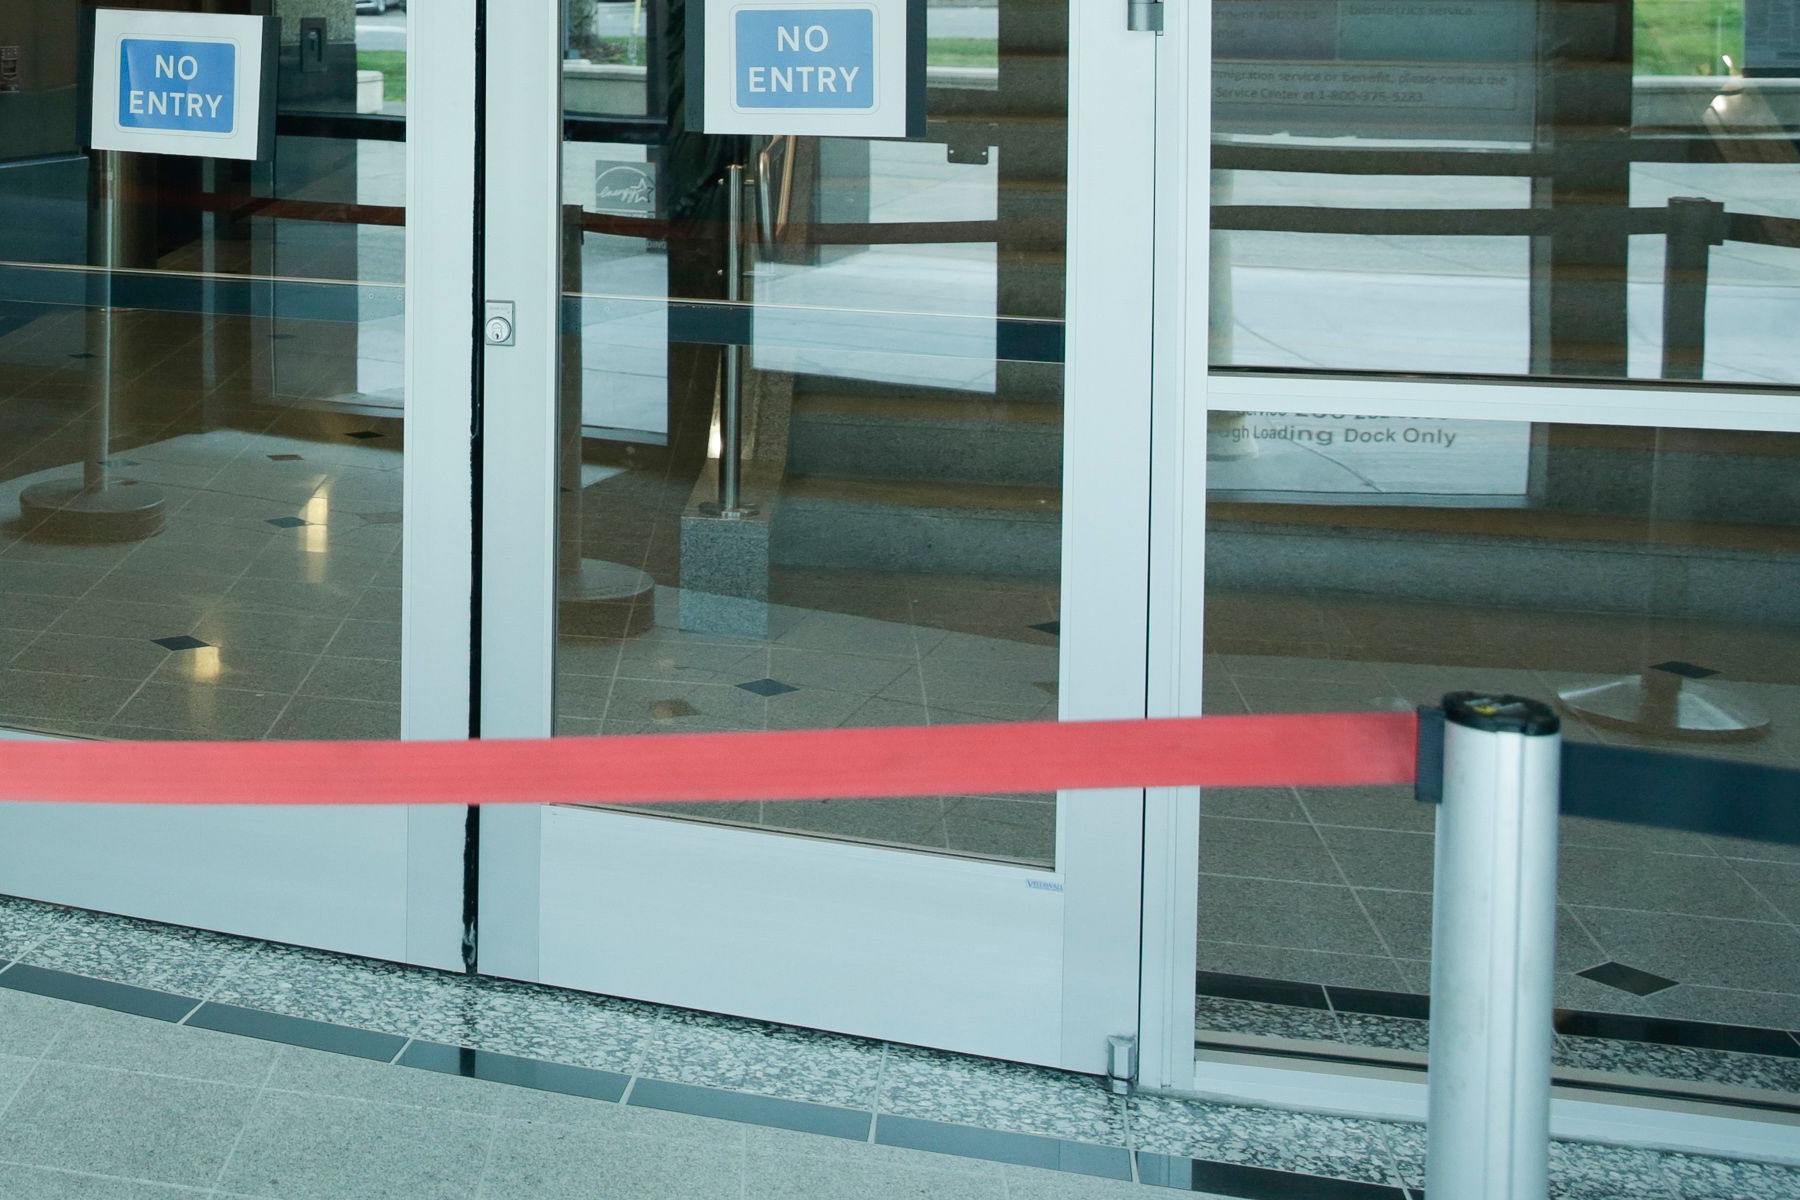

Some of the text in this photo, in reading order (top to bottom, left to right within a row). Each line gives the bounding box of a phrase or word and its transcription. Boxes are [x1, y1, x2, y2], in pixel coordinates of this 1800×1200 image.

[777, 26, 828, 52] NO
[155, 54, 198, 80] NO
[749, 67, 860, 93] ENTRY
[129, 90, 222, 119] ENTRY
[1254, 426, 1333, 446] Loading
[1344, 429, 1396, 443] Dock
[1403, 428, 1457, 448] Only
